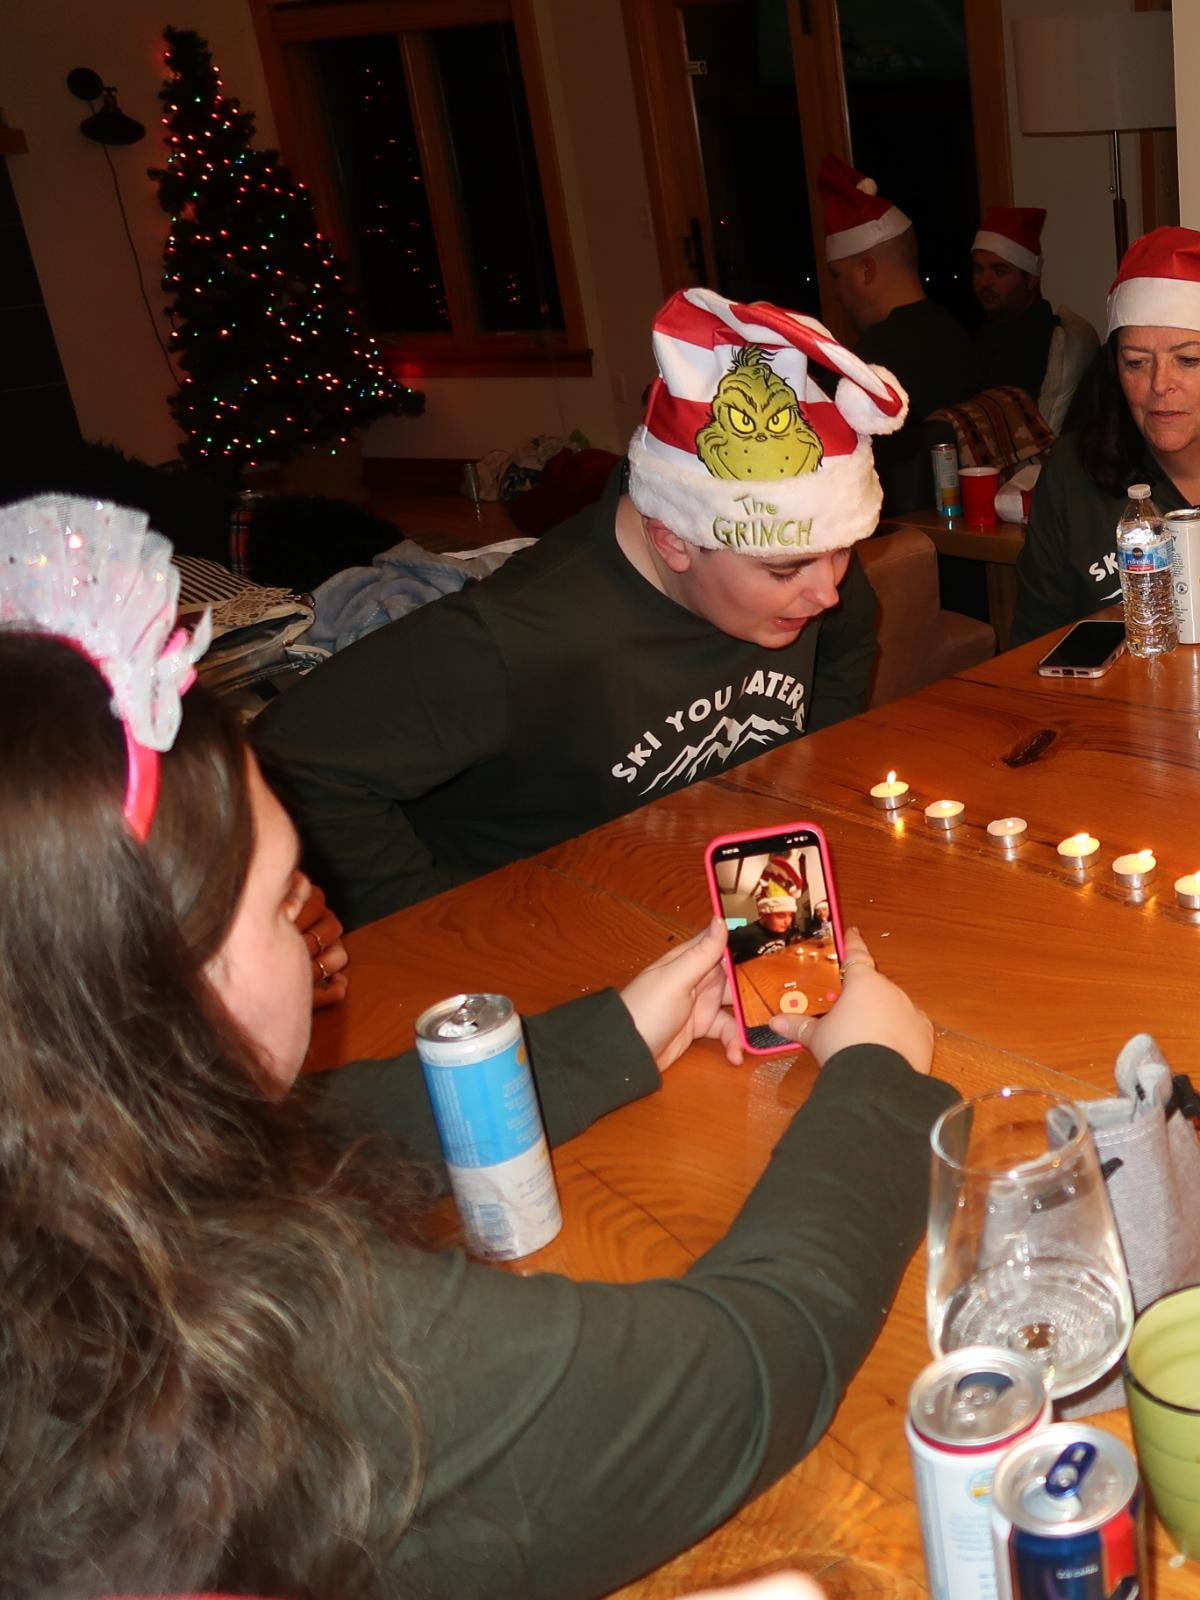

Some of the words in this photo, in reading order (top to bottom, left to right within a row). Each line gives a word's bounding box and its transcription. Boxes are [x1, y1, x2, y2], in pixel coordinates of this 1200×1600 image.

[733, 494, 777, 515] The
[712, 516, 814, 548] GRINCH
[1088, 552, 1119, 582] SK
[611, 731, 662, 783] SKI
[665, 685, 732, 733] YOU
[739, 670, 805, 709] ATER
